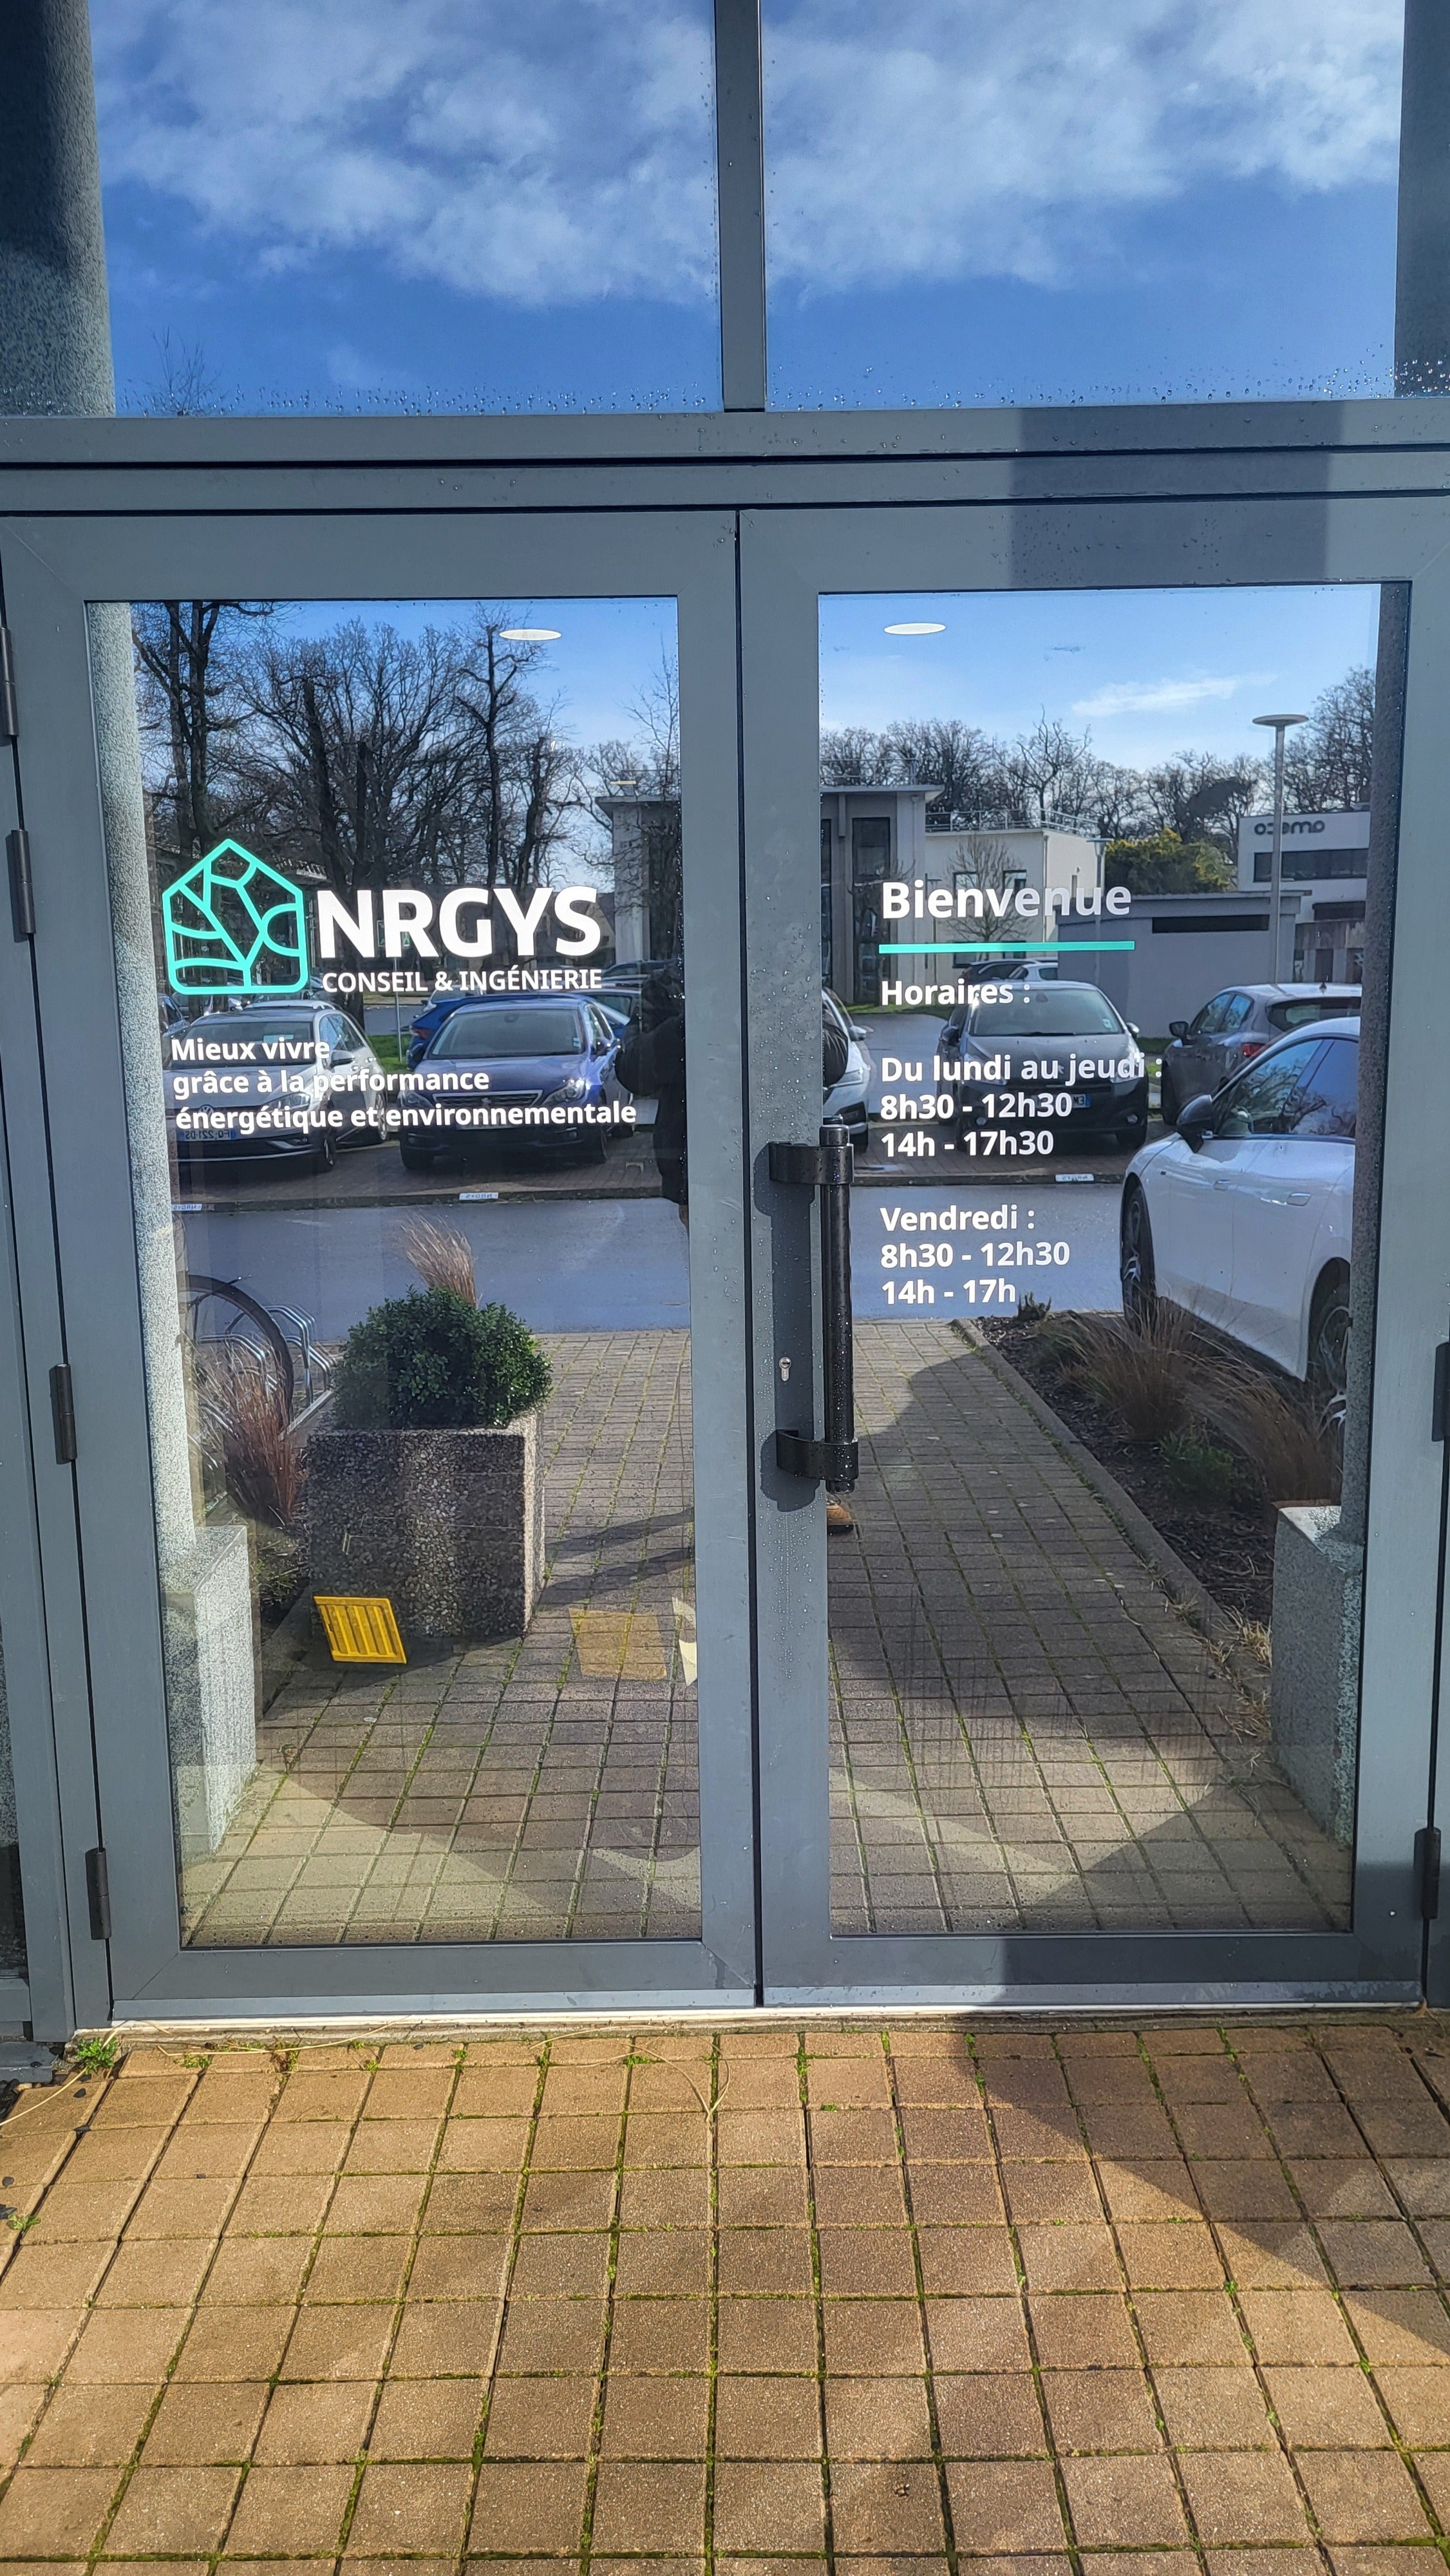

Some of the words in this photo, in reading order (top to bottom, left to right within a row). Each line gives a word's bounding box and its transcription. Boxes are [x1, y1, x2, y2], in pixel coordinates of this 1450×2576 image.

[882, 879, 1131, 920] Bienvenue
[317, 886, 601, 959] NRGYS
[323, 972, 428, 992] CONSEIL
[435, 971, 453, 991] &
[459, 965, 602, 990] INGÉNIERIE
[881, 978, 1013, 1006] Horaires
[171, 1038, 256, 1061] Mieux
[261, 1037, 330, 1059] vivre
[173, 1070, 250, 1097] grâce
[257, 1069, 273, 1094] à
[281, 1070, 304, 1093] la
[312, 1068, 490, 1098] performance
[881, 1057, 923, 1083] Du
[934, 1054, 1011, 1081] lundi
[1021, 1060, 1058, 1080] au
[1064, 1053, 1145, 1086] jeudi
[175, 1106, 343, 1135] énergétique
[351, 1106, 379, 1127] et
[386, 1101, 637, 1127] environnementale
[880, 1094, 954, 1120] 8h30
[982, 1092, 1073, 1118] 12h30
[881, 1131, 935, 1157] 14h
[963, 1130, 1054, 1156] 17h30
[880, 1204, 1017, 1231] Vendredi
[881, 1243, 954, 1268] 8h30
[981, 1242, 1070, 1267] 12h30
[881, 1279, 934, 1305] 14h
[963, 1278, 1015, 1303] 17h
